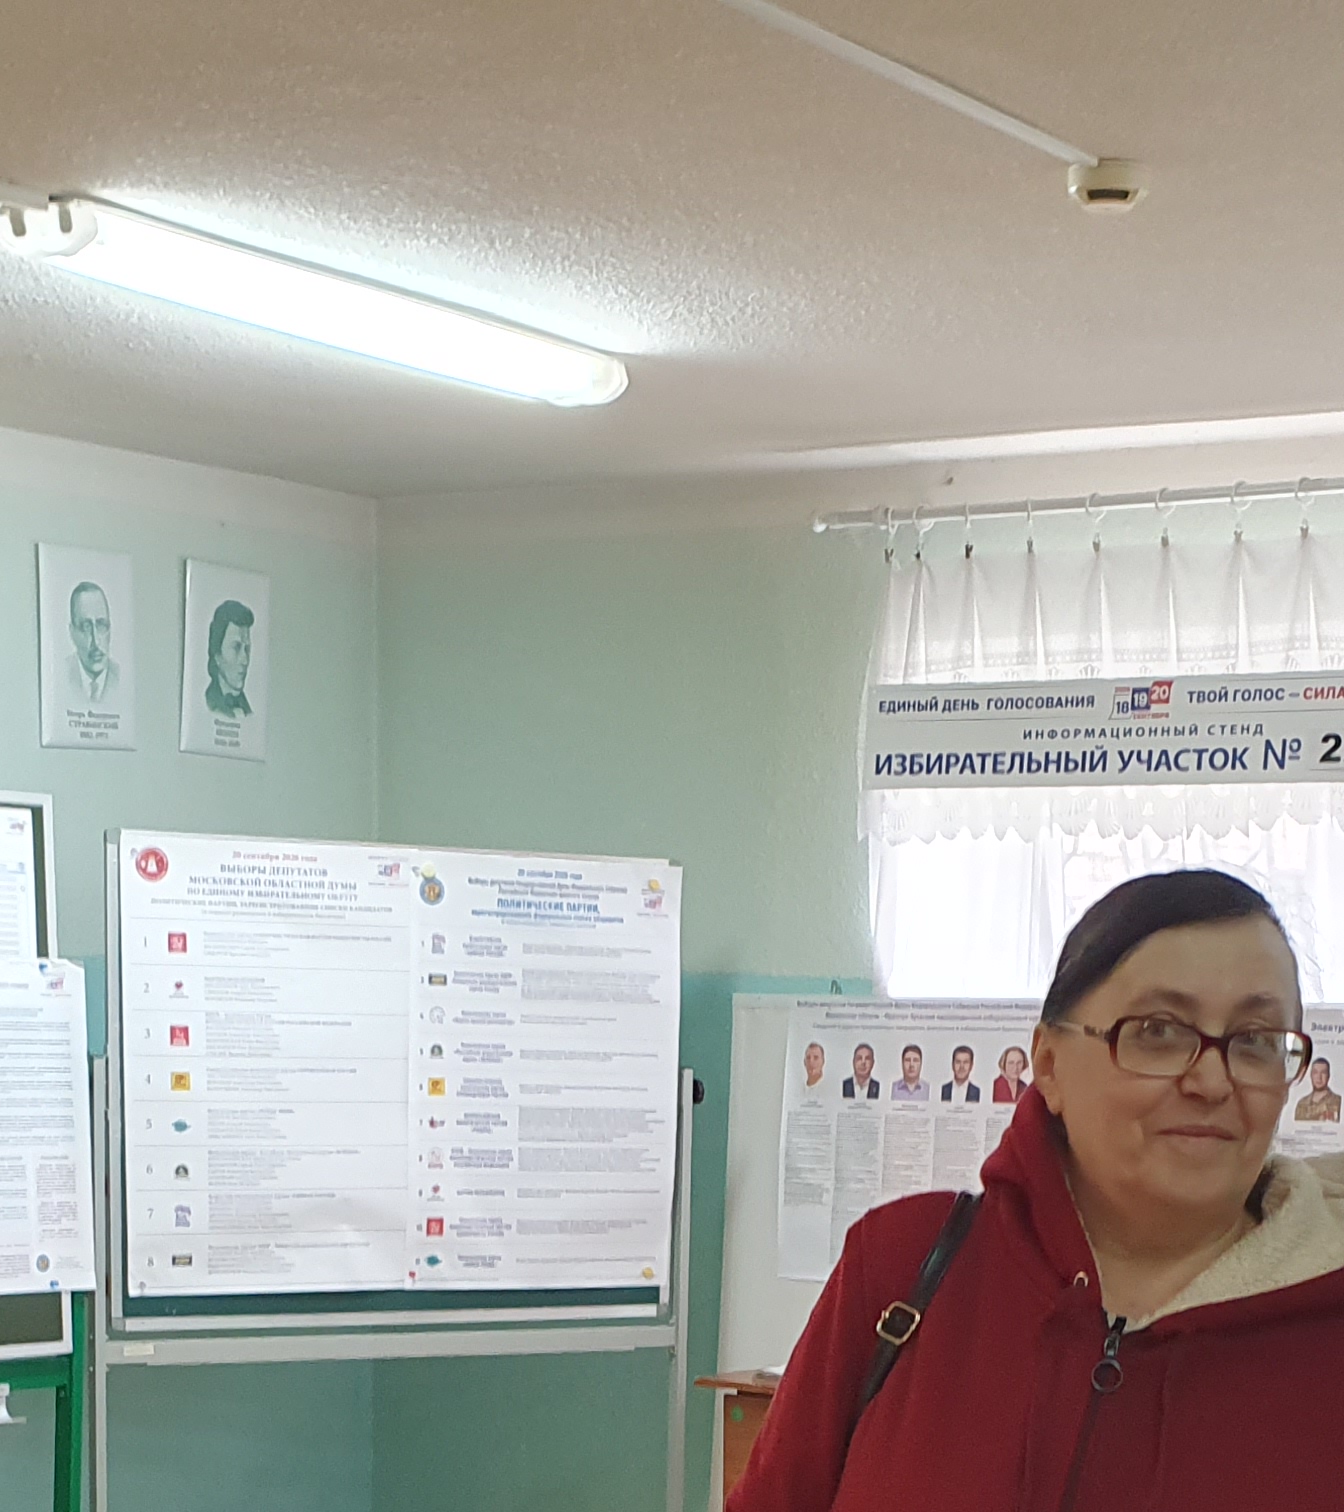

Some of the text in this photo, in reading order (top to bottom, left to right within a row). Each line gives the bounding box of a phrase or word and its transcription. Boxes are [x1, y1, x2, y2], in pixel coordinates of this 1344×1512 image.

[1116, 685, 1170, 715] 18 19 20
[1187, 686, 1229, 704] ТВОЙ
[1232, 687, 1286, 703] ГОЛОС
[879, 695, 1096, 715] ЕДИНЫЙ ДЕНЬ ГОЛОСОВАНИЯ
[1022, 723, 1265, 741] ИНФОРМАЦИОННЫЙ СТЕНД
[874, 745, 1108, 776] ИЗБИРАТЕЛЬНЫЙ
[1117, 746, 1251, 774] УЧАСТОК
[1262, 738, 1303, 772] №
[220, 864, 329, 878] ВЫБОРЫ ДЕПУТАТОВ
[188, 875, 358, 892] МОСКОВСКОЙ ОБЛАСТНОЙ ДУМЫ
[497, 897, 565, 913] ПОЛИТИЧЕСКИЕ
[143, 982, 150, 994] 2
[144, 1028, 151, 1040] 3
[145, 1073, 152, 1085] 4
[145, 1118, 153, 1130] 5
[146, 1164, 154, 1176] 6
[146, 1207, 155, 1220] 7
[147, 1256, 155, 1268] 8
